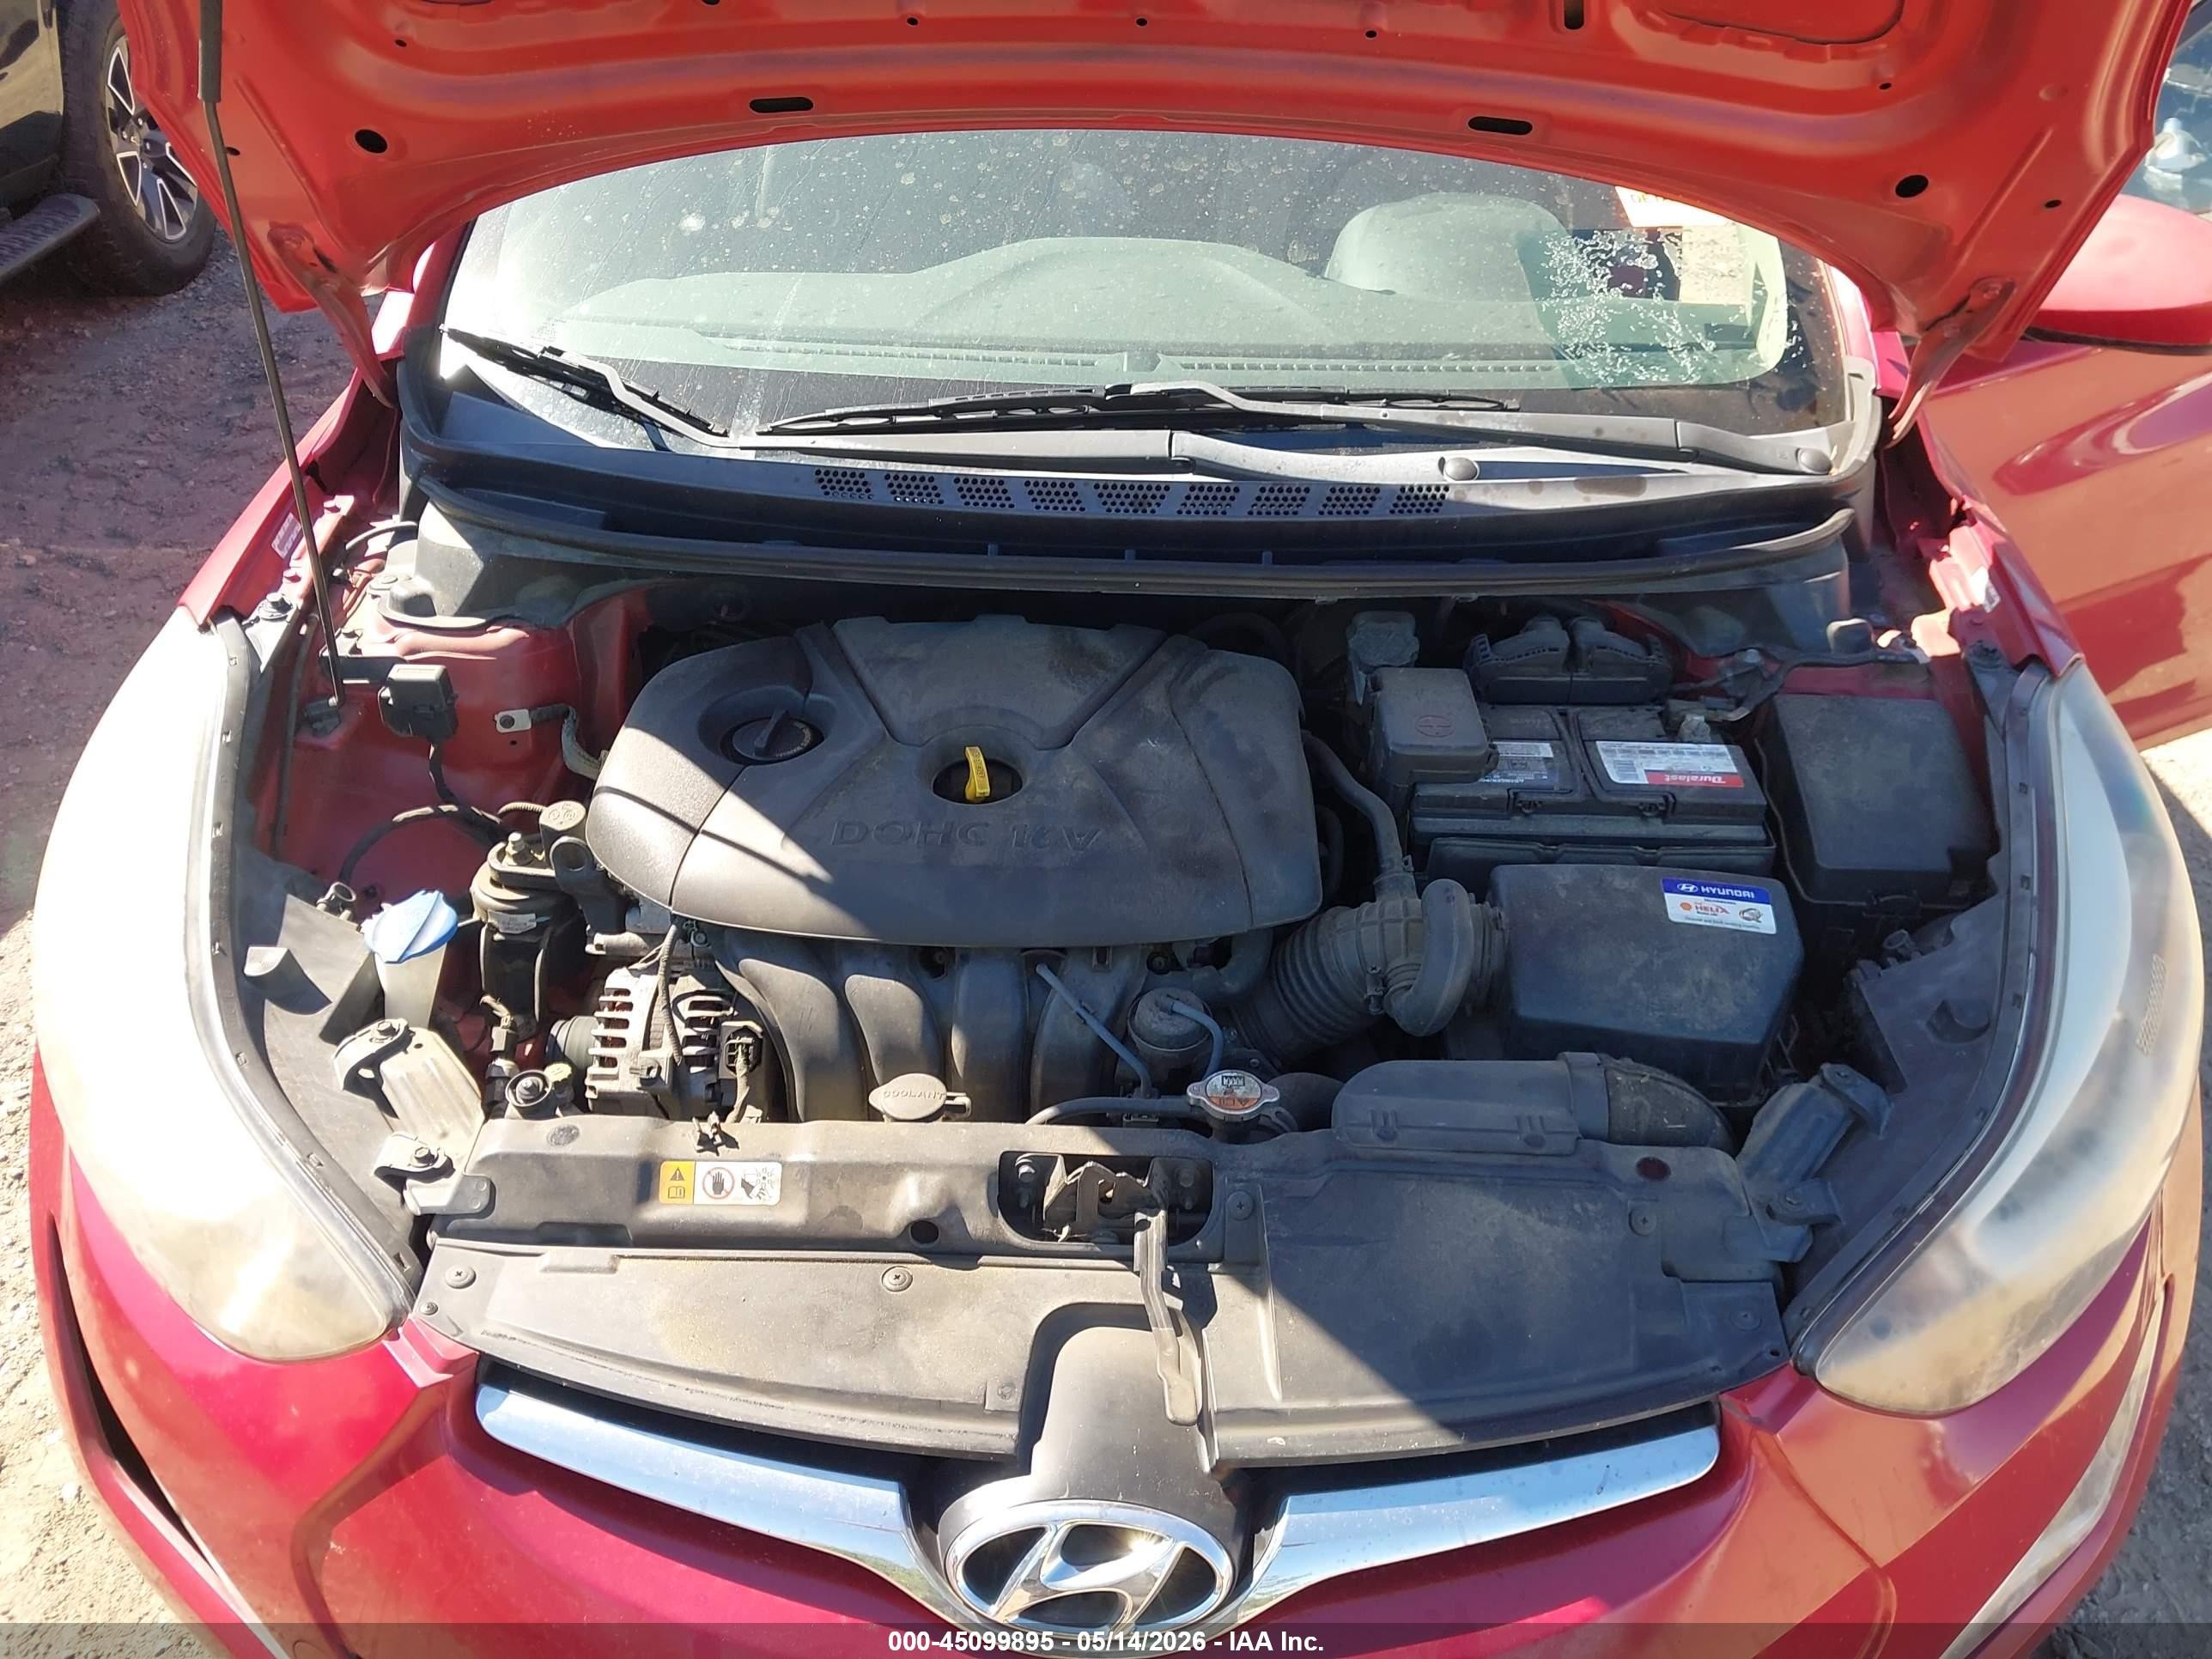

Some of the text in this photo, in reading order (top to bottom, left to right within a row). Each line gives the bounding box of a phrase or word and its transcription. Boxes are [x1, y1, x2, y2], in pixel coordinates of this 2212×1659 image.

[1664, 775, 1726, 784] Duralast
[830, 819, 990, 847] DOHC
[1700, 885, 1755, 899] HYUNDAI
[883, 1090, 946, 1100] COOLANT
